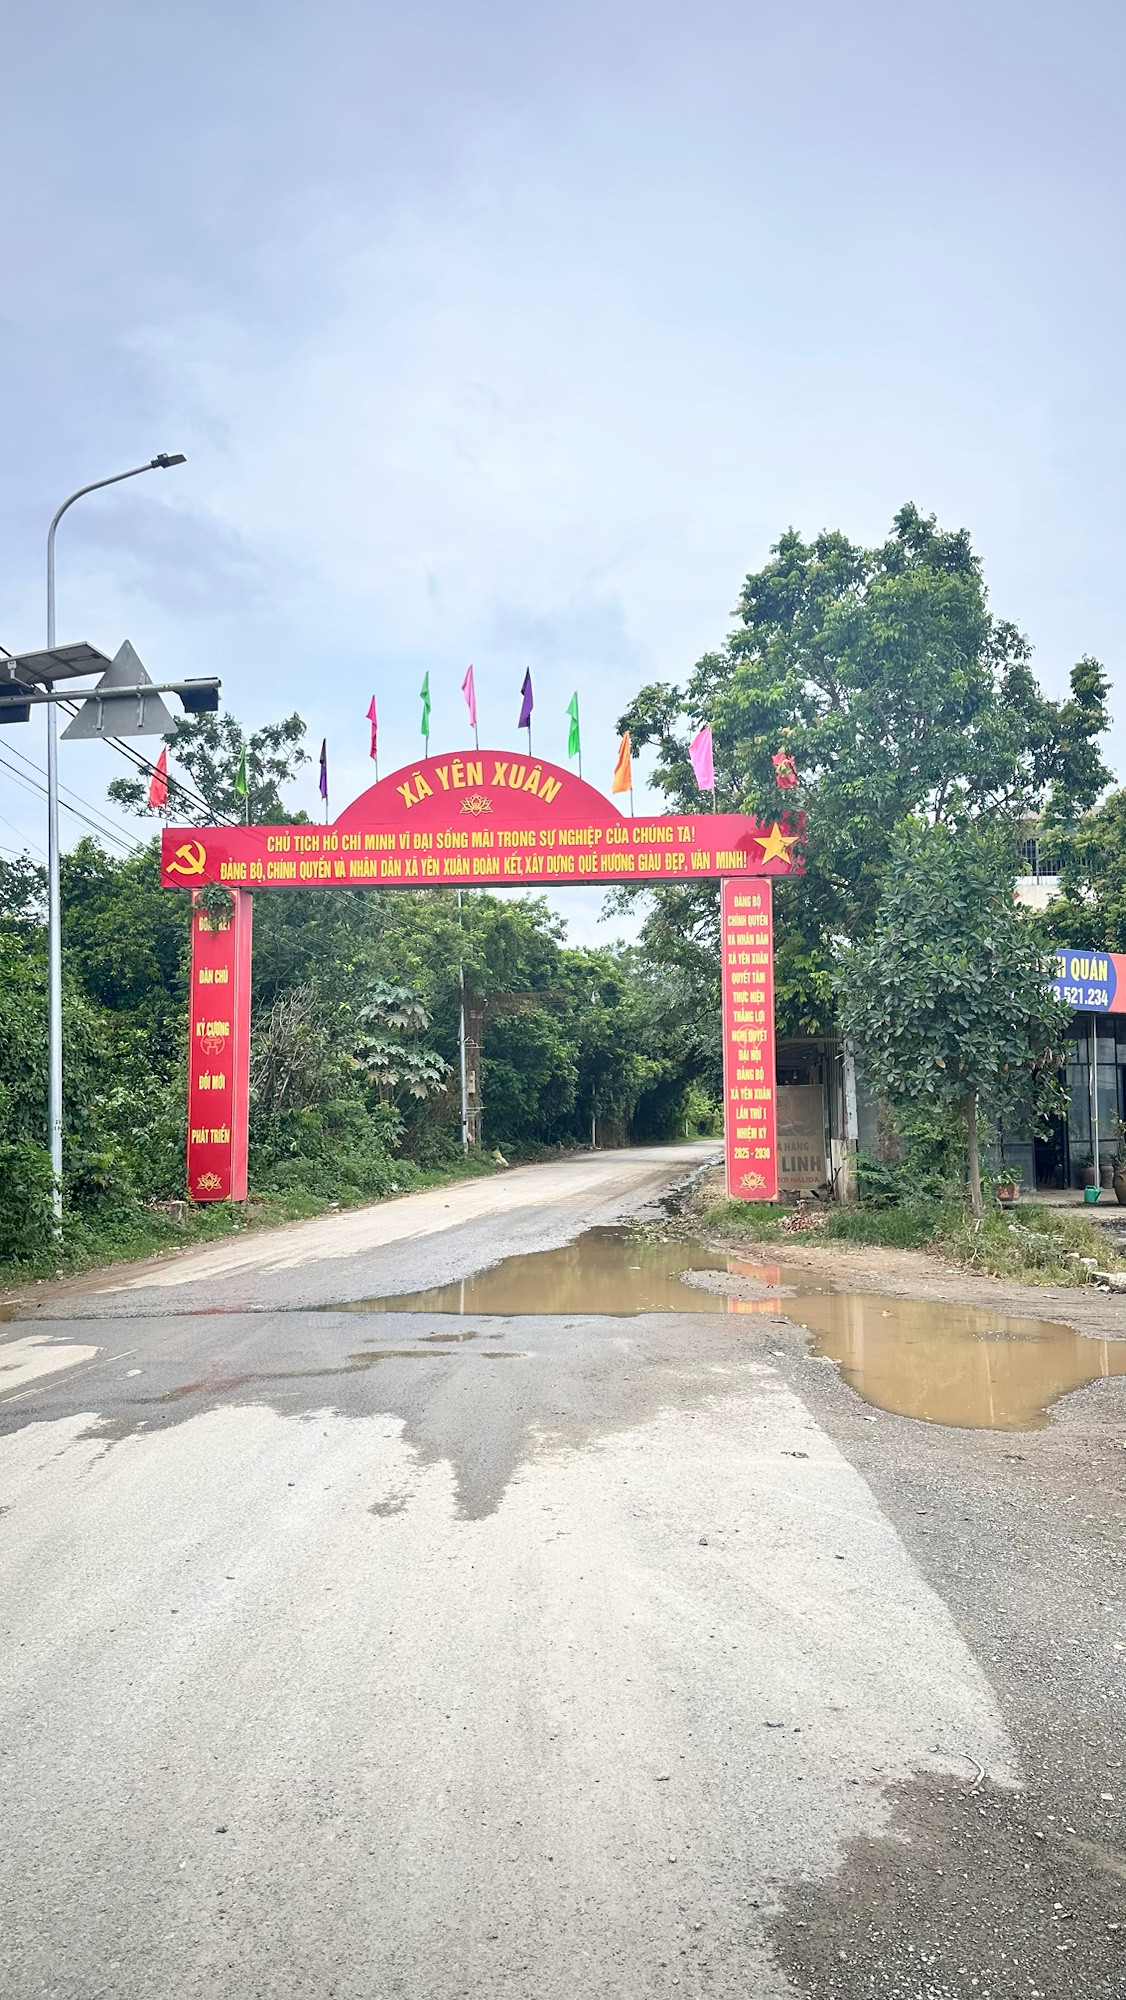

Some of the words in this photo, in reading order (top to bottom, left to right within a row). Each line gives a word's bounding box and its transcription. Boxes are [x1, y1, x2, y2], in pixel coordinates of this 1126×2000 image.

[395, 770, 434, 809] XÃ
[435, 758, 483, 791] YÊN
[491, 761, 563, 804] XUÂN
[267, 830, 291, 852] CHỦ
[294, 835, 320, 855] TỊCH
[322, 829, 339, 851] HỒ
[341, 831, 362, 851] CHÍ
[364, 834, 396, 851] MINH
[399, 830, 411, 850] VĨ
[413, 833, 433, 853] ĐẠI
[436, 827, 469, 849] SỐNG
[471, 828, 494, 848] MÃI
[497, 830, 536, 847] TRONG
[539, 828, 557, 850] SỰ
[558, 825, 602, 848] NGHIỆP
[605, 822, 630, 844] CỦA
[632, 823, 674, 844] CHÚNG
[677, 825, 695, 843] TA!
[220, 857, 247, 880] ĐẢNG
[249, 858, 266, 883] BỘ,
[266, 858, 297, 879] CHÍNH
[299, 855, 331, 880] QUYỀN
[333, 857, 346, 878] VÀ
[349, 856, 377, 878] NHÂN
[380, 856, 401, 877] DÂN
[404, 855, 419, 877] XÃ
[421, 855, 440, 876] YÊN
[443, 854, 470, 876] XUÂN
[472, 853, 500, 875] ĐOÀN
[503, 851, 523, 876] KẾT,
[525, 852, 544, 874] XÂY
[546, 854, 575, 877] DỰNG
[578, 851, 598, 875] QUÊ
[601, 852, 635, 872] HƯƠNG
[638, 850, 661, 871] GIÀU
[665, 852, 688, 874] ĐẸP,
[691, 848, 711, 870] VĂN
[715, 850, 747, 869] MINH!
[734, 892, 752, 907] ĐẢNG
[752, 893, 762, 910] BỘ
[727, 912, 747, 926] CHÍNH
[727, 932, 736, 945] VÀ
[736, 931, 755, 945] NHÂN
[755, 931, 769, 945] DÂN
[728, 951, 737, 965] XÃ
[738, 950, 751, 965] YÊN
[751, 950, 769, 965] XUÂN
[199, 966, 214, 984] DÂN
[214, 964, 229, 984] CHỦ
[731, 968, 751, 985] QUYẾT
[752, 969, 766, 984] TÂM
[1070, 957, 1108, 982] QUÁN
[733, 990, 749, 1006] THỰC
[750, 989, 765, 1006] HIỆN
[733, 1006, 754, 1023] THẮNG
[754, 1009, 766, 1025] LỢI
[196, 1017, 206, 1037] KỶ
[206, 1020, 230, 1037] CƯƠNG
[738, 1049, 750, 1064] ĐẠI
[750, 1047, 762, 1064] HỘI
[198, 1069, 211, 1090] ĐỔI
[211, 1072, 226, 1090] MỚI
[736, 1065, 755, 1081] ĐẢNG
[755, 1066, 765, 1083] BỘ
[730, 1086, 740, 1100] XÃ
[740, 1086, 753, 1100] YÊN
[754, 1085, 772, 1100] XUÂN
[191, 1126, 209, 1144] PHÁT
[210, 1122, 230, 1144] TRIỂN
[734, 1147, 750, 1160] 2025
[754, 1147, 771, 1160] 2030
[781, 1156, 821, 1172] LINH
